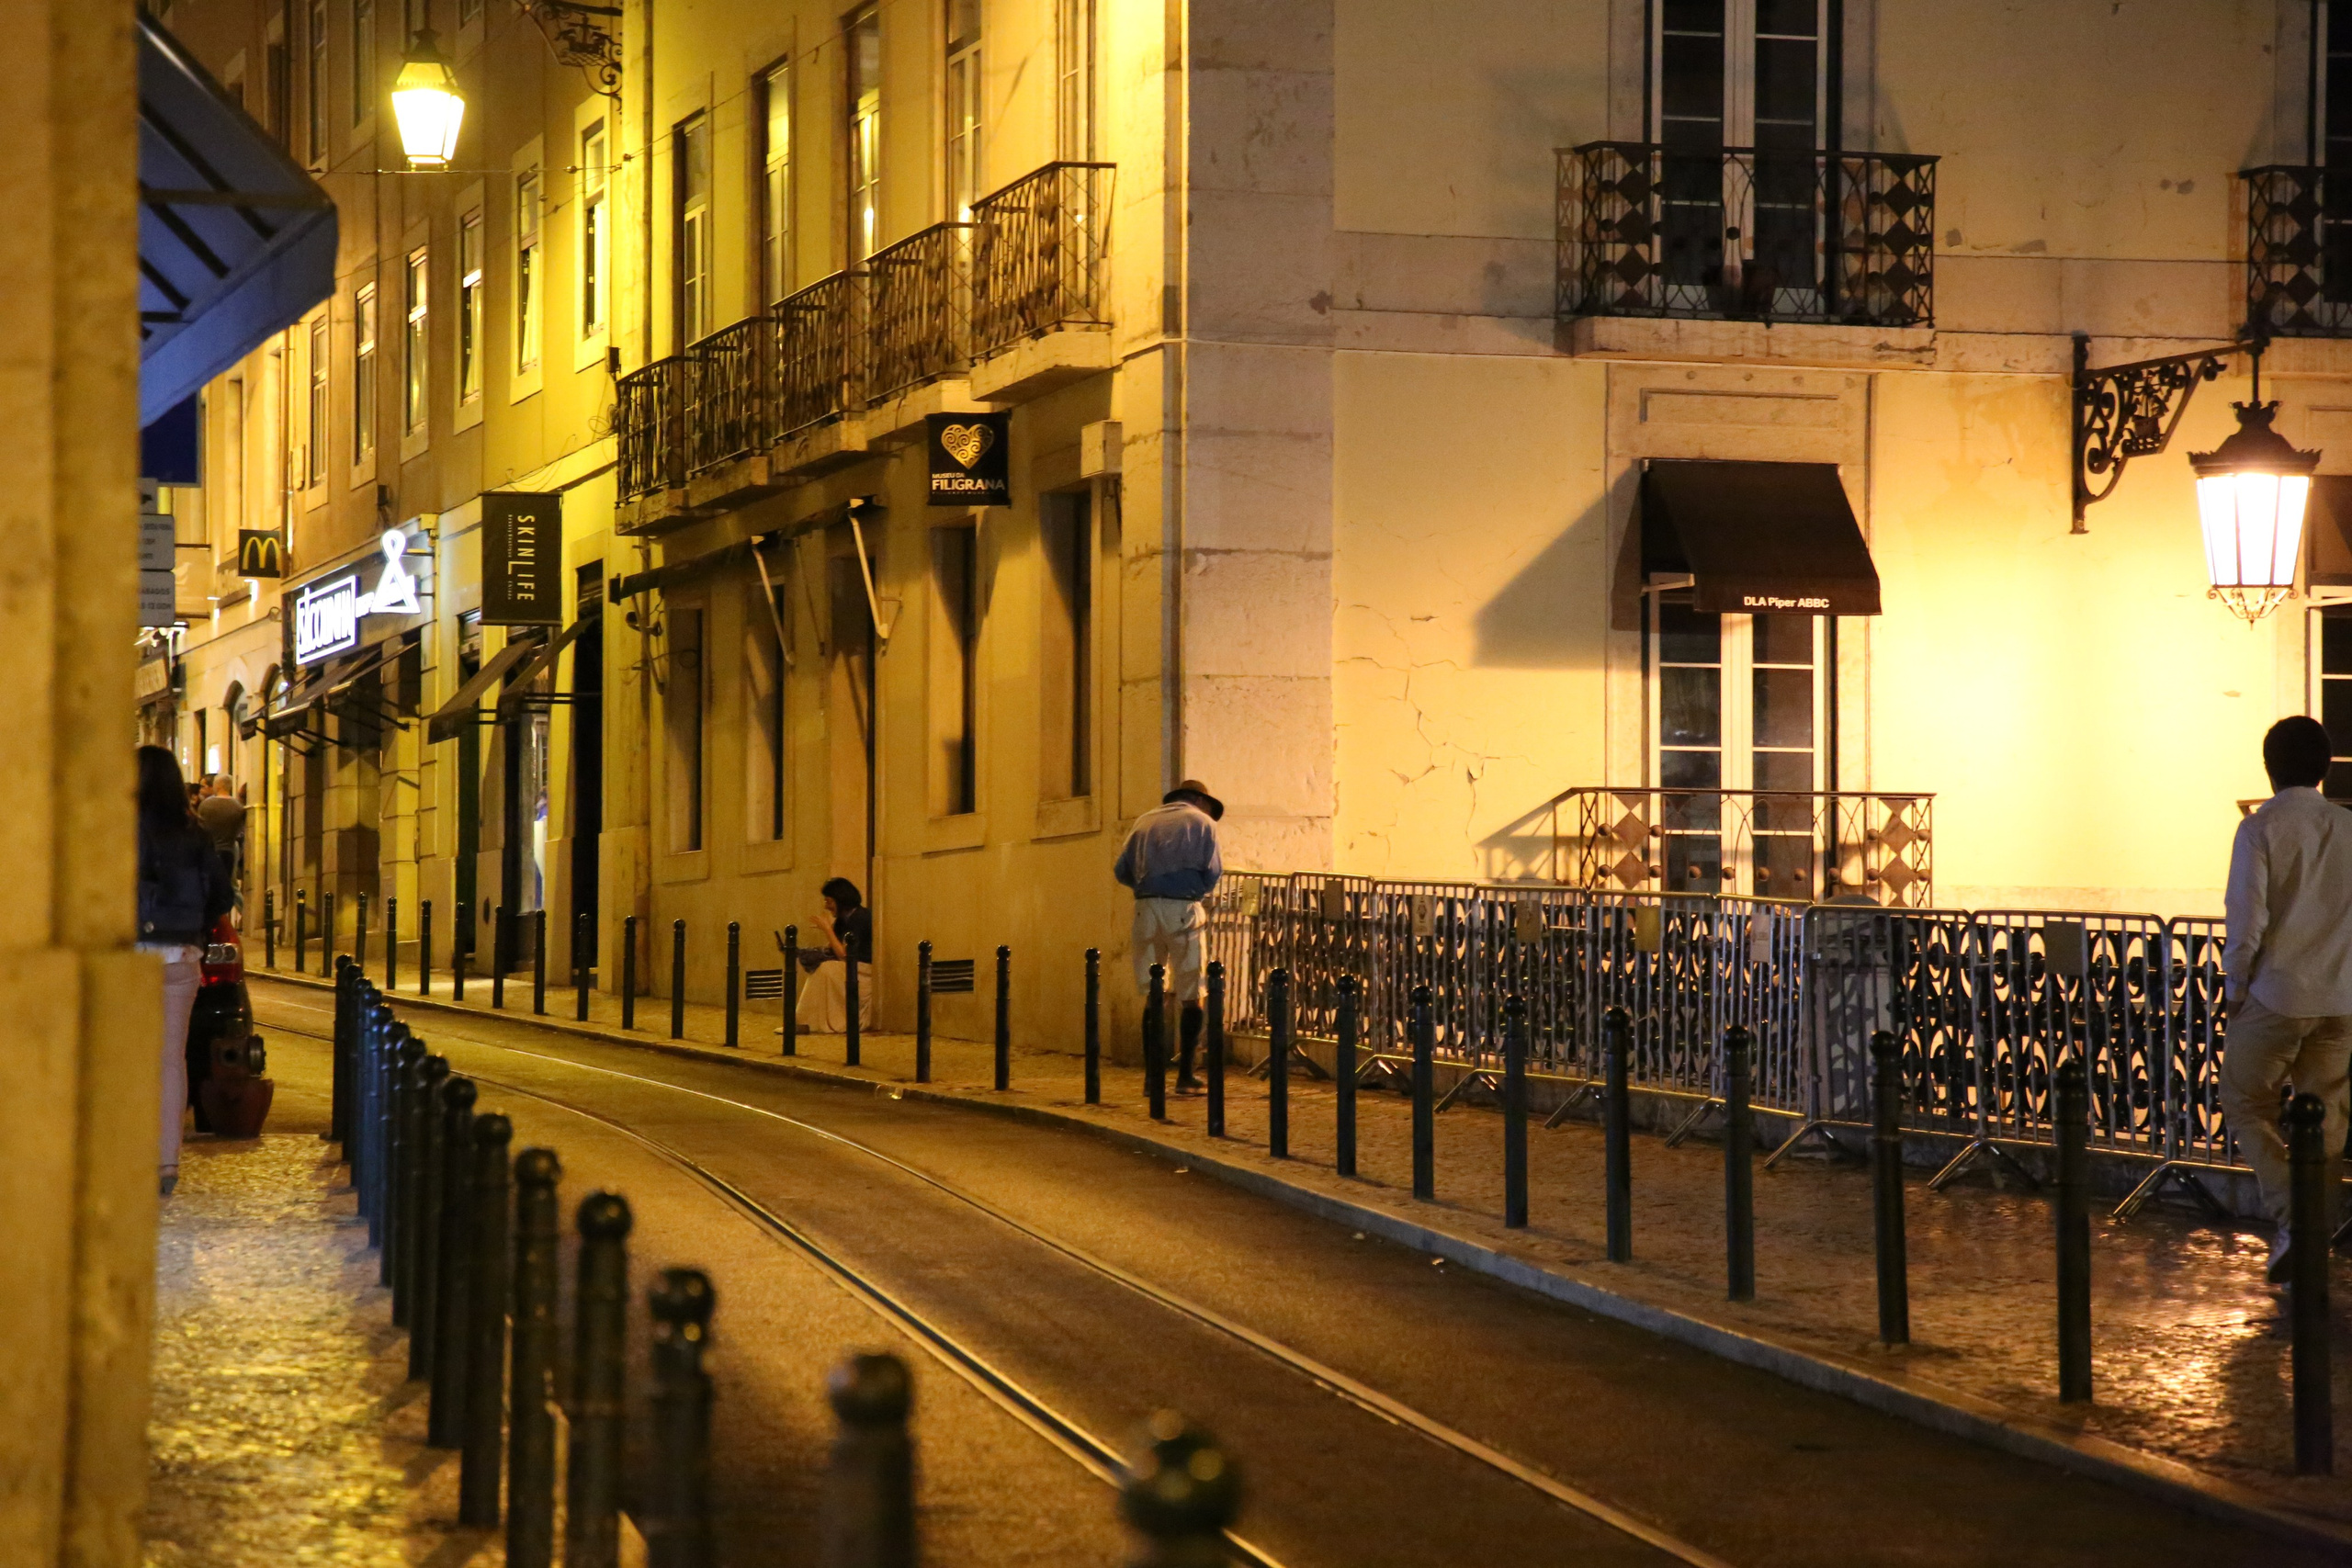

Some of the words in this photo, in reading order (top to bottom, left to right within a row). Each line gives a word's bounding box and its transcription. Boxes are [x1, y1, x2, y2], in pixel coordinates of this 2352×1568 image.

[932, 479, 1005, 491] FILIGRANA
[507, 514, 536, 601] SKINLIFE
[1743, 596, 1767, 606] DLA
[1768, 597, 1797, 609] Piper
[1797, 598, 1830, 608] ABBC
